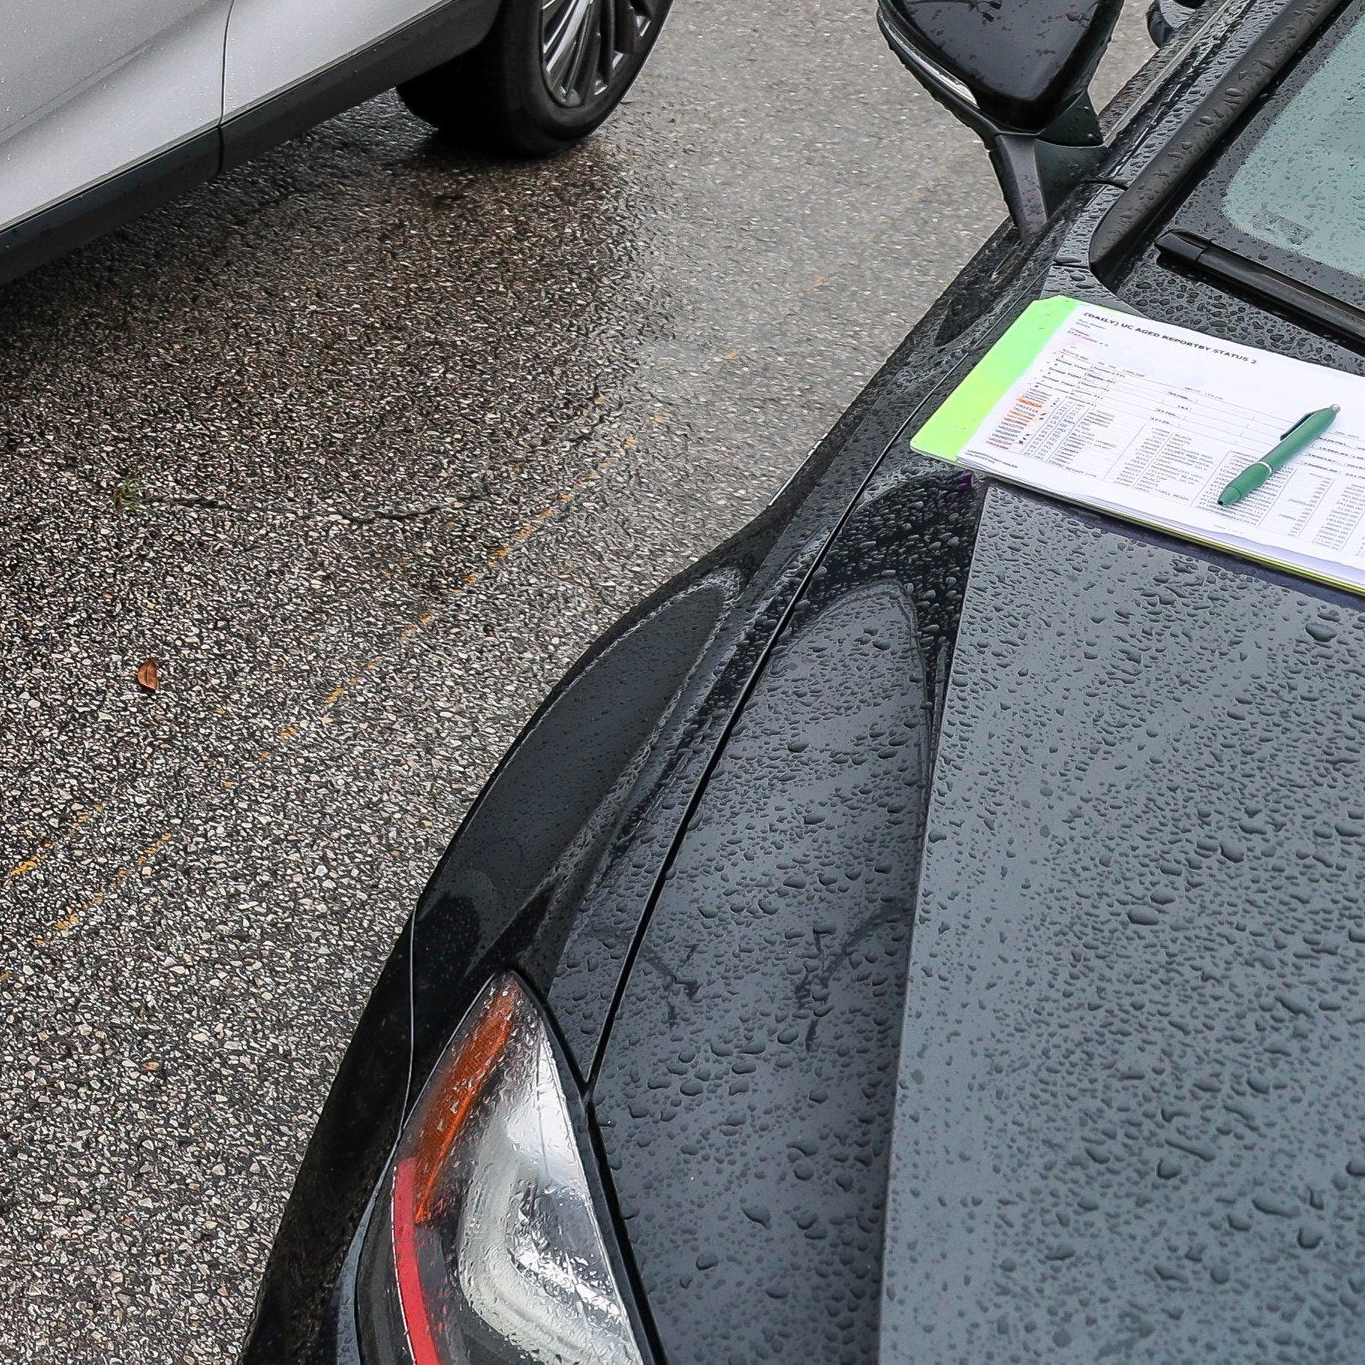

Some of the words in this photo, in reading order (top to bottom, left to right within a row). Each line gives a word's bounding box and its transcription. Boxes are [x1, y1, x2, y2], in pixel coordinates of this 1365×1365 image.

[1084, 312, 1119, 326] (DAILY)
[1135, 328, 1160, 337] AGED
[1212, 349, 1249, 362] STATUS
